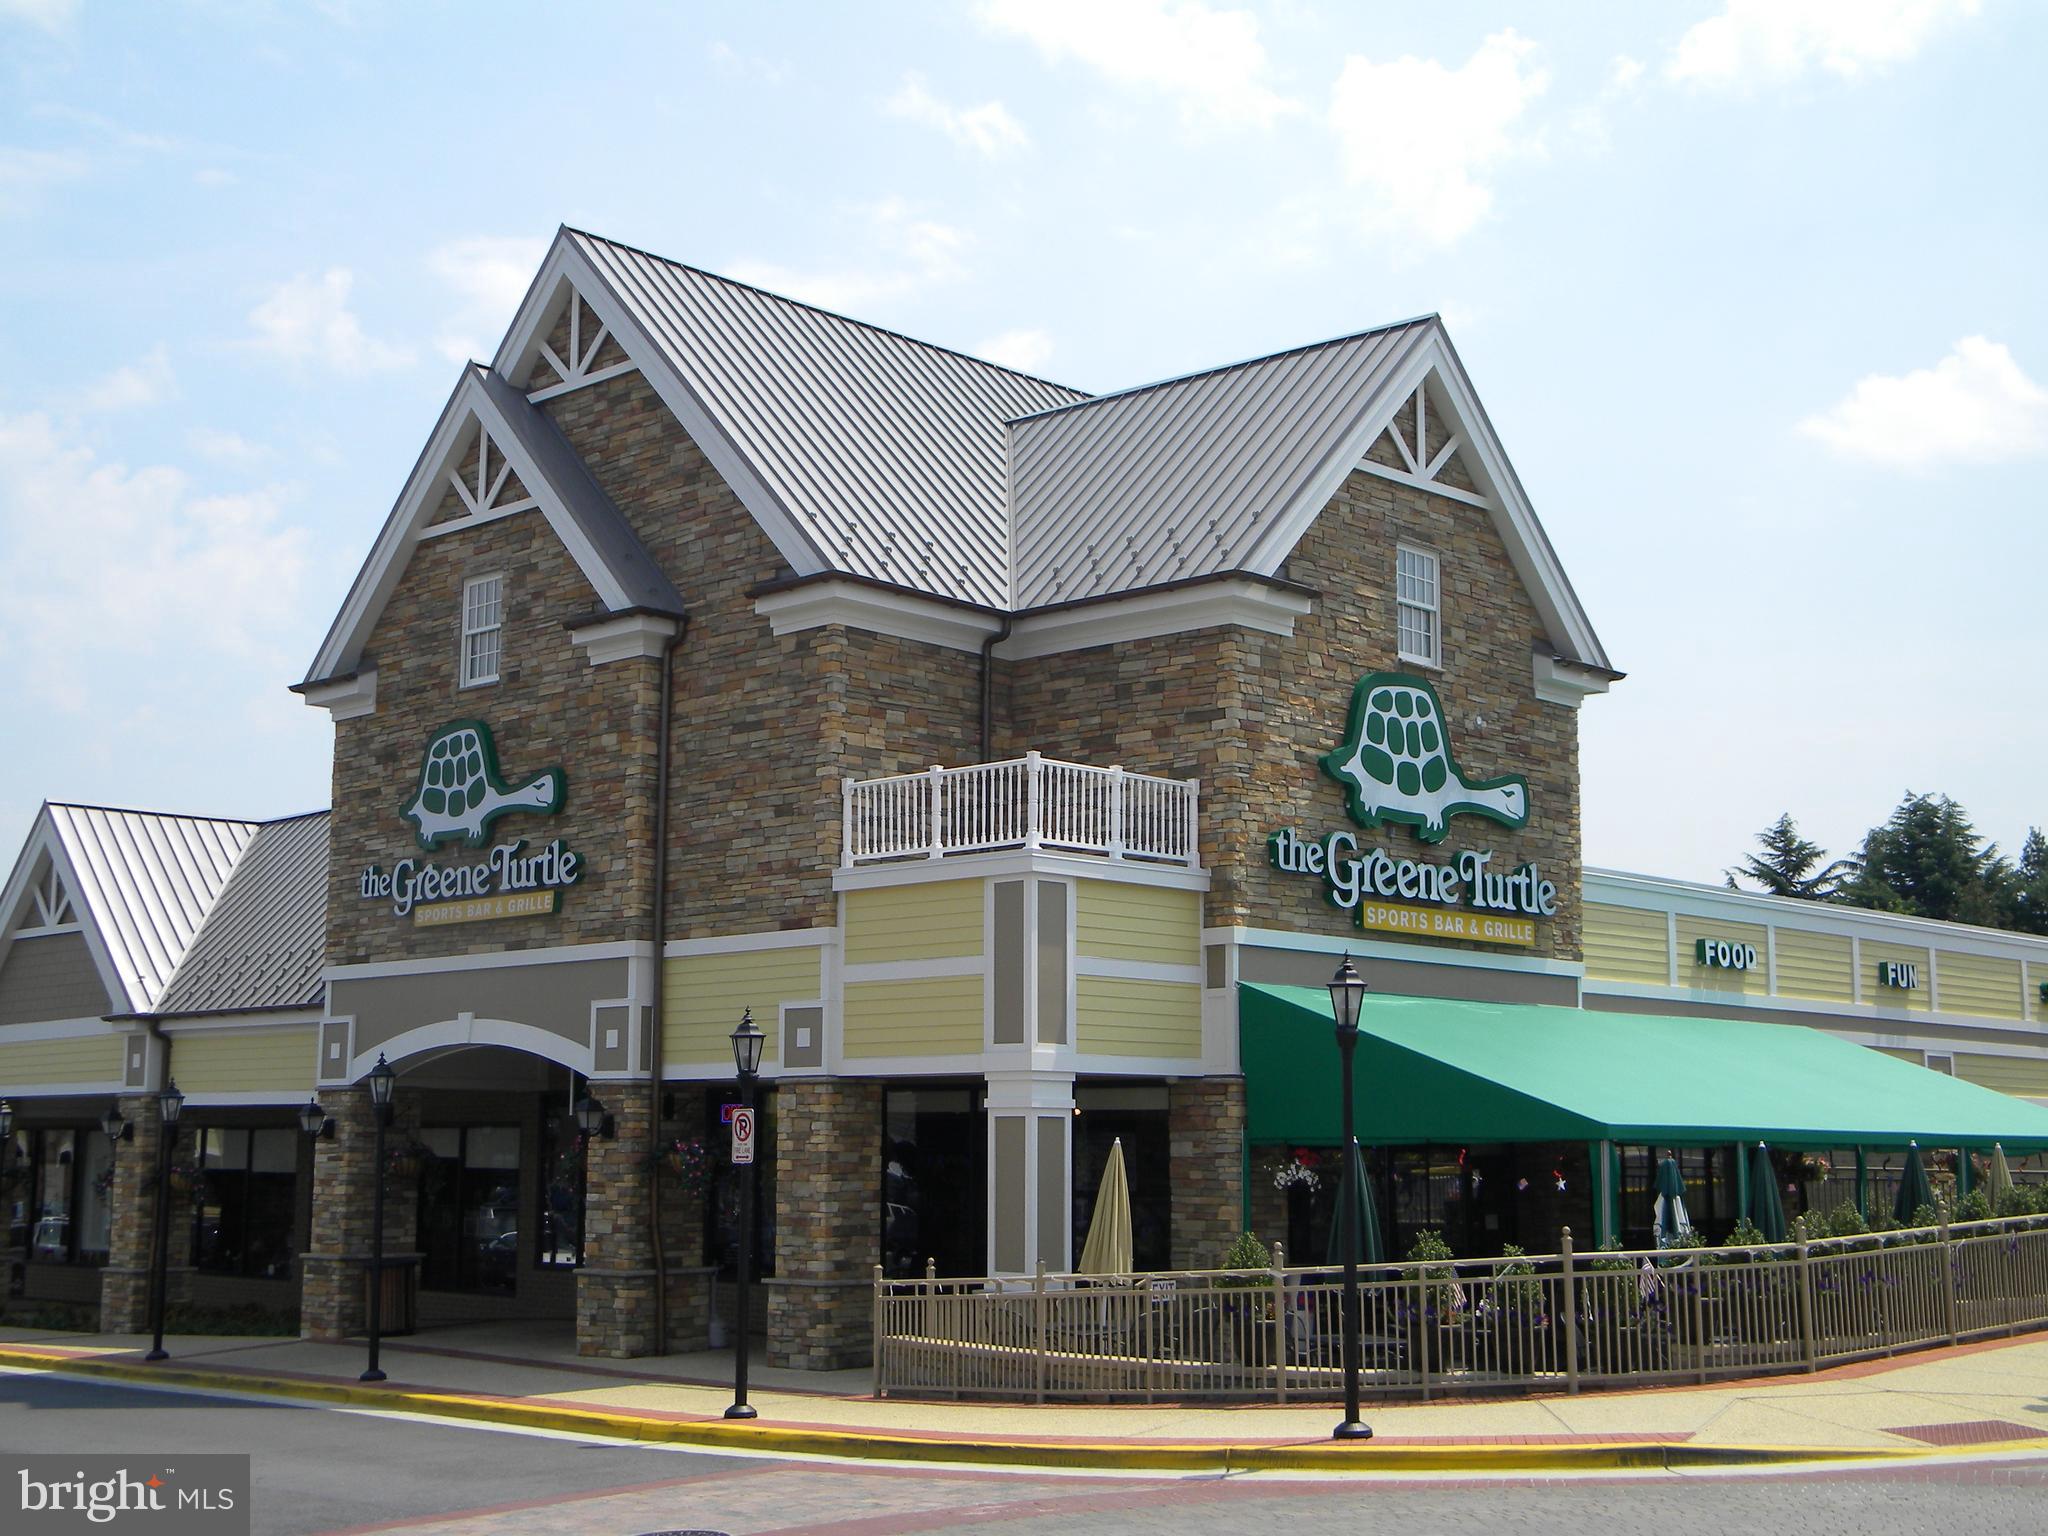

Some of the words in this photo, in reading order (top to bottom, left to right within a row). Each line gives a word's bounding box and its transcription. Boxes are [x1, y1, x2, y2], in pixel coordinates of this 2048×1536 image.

[361, 865, 391, 898] the
[391, 858, 491, 917] Greene
[490, 839, 578, 891] Turtle
[1276, 828, 1324, 874] the
[1327, 831, 1459, 908] Greene
[1459, 849, 1557, 916] Turtle
[417, 906, 463, 923] SPORTS
[467, 902, 492, 917] BAR
[496, 900, 503, 914] &
[508, 895, 551, 913] GRILLE
[1367, 907, 1428, 930] SPORTS
[1434, 915, 1464, 934] BAR
[1470, 920, 1478, 936] &
[1484, 921, 1532, 942] GRILLE
[1703, 939, 1757, 970] FOOD
[1886, 962, 1919, 989] FUN
